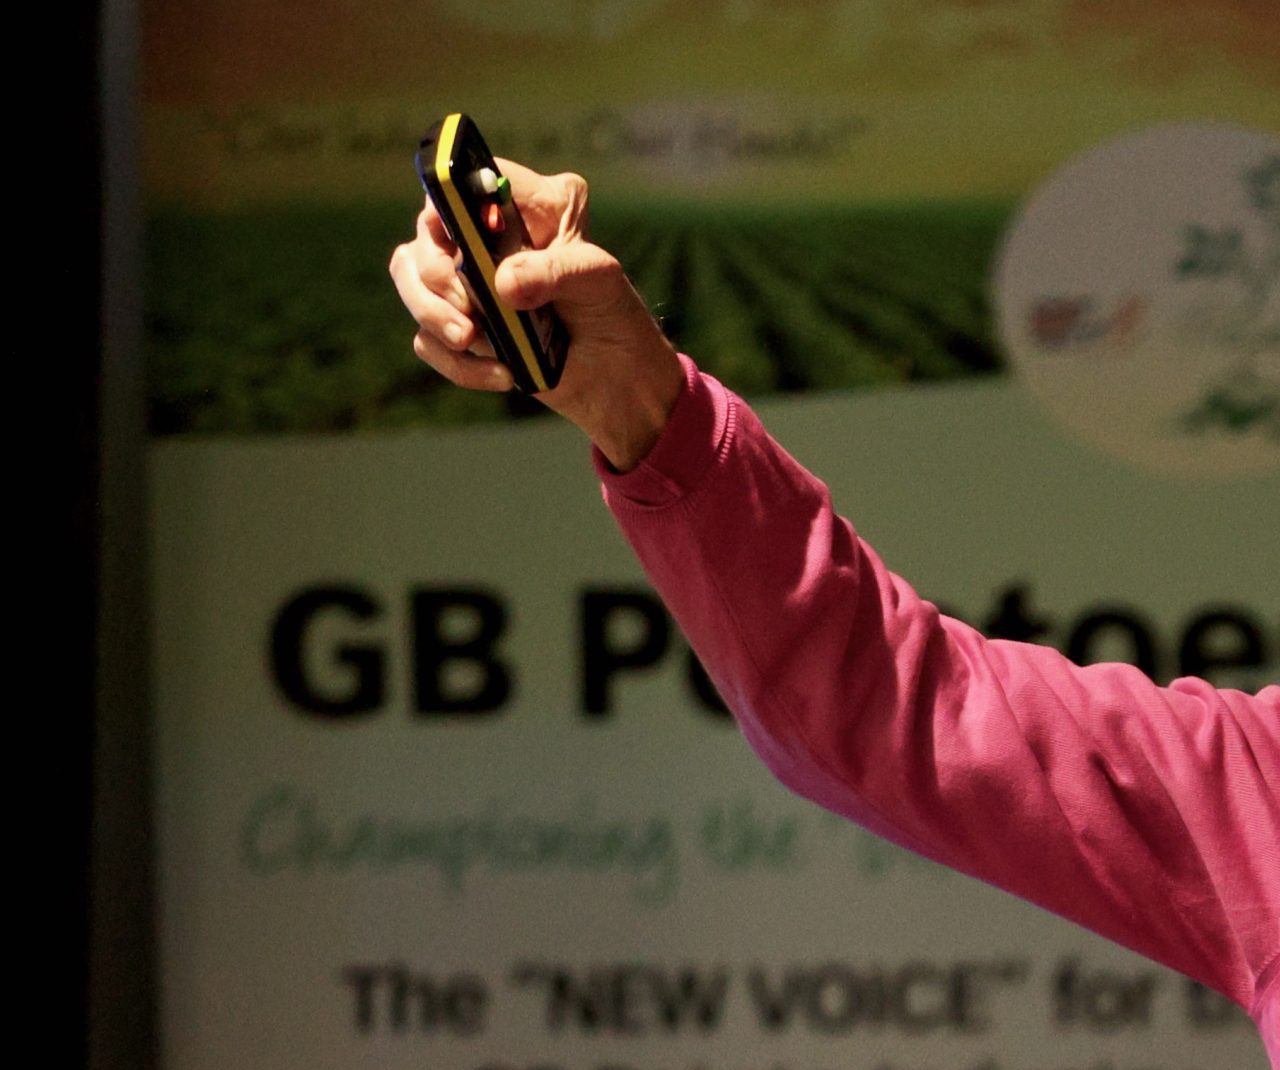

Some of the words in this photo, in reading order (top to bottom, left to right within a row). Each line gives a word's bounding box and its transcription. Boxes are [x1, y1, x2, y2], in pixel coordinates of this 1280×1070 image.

[270, 580, 514, 718] GB
[238, 784, 678, 908] Championing
[346, 962, 489, 1036] The
[1053, 956, 1157, 1032] for
